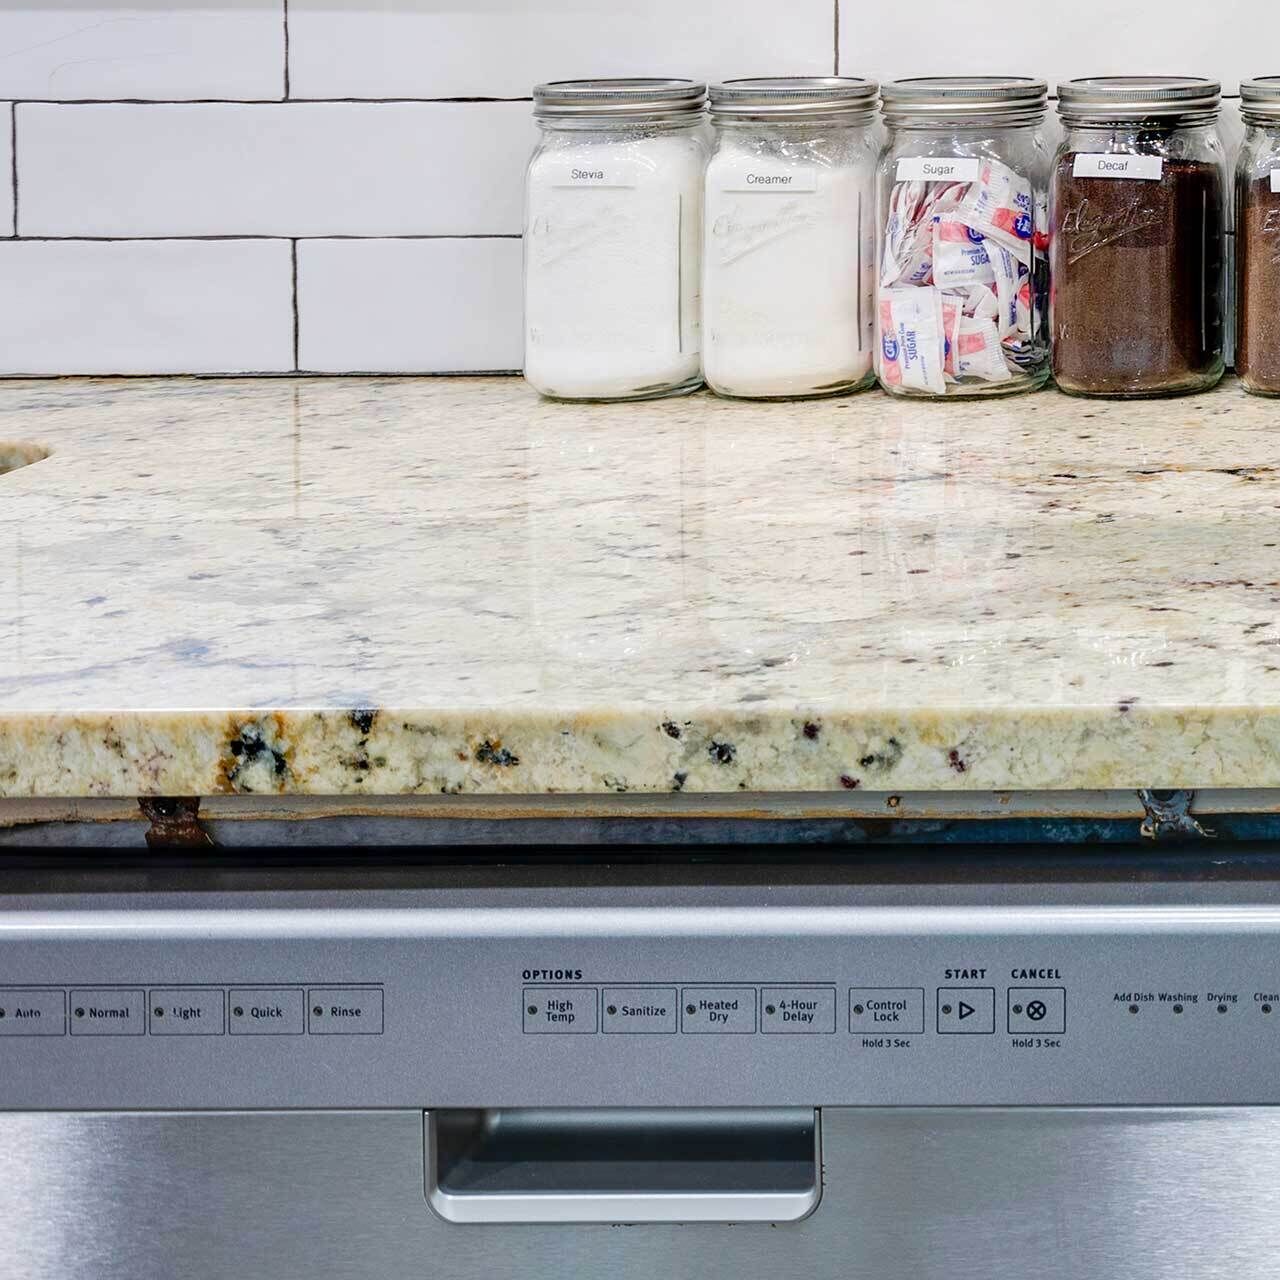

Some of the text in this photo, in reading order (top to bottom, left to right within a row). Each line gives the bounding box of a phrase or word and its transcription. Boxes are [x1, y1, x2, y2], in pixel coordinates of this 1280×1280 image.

[923, 163, 955, 175] Sugar
[1097, 160, 1129, 172] Decaf
[571, 168, 604, 181] Stevia
[746, 173, 792, 185] Creamer
[970, 253, 990, 266] SUGA
[906, 331, 917, 360] SUGAR
[522, 969, 583, 980] OPTIONS
[944, 969, 987, 979] START
[1011, 969, 1062, 979] CANCEL
[1113, 992, 1154, 1002] Add Dish
[1158, 992, 1198, 1003] Washing
[1207, 992, 1238, 1003] Drying
[1253, 992, 1280, 1002] Clean
[548, 1000, 573, 1011] High
[699, 1000, 738, 1010] Heated
[779, 1000, 818, 1010] 4-Hour
[866, 1000, 907, 1010] Control
[15, 1008, 41, 1018] Auto
[89, 1008, 129, 1018] Normal
[251, 1006, 282, 1018] Quick
[330, 1006, 361, 1017] Rinse
[621, 1006, 666, 1016] Sanitize
[873, 1011, 899, 1022] Lock
[546, 1011, 575, 1024] Temp
[709, 1012, 728, 1024] Dry
[783, 1011, 814, 1024] Delay
[862, 1039, 911, 1048] Hold 3 Sec
[1012, 1038, 1061, 1048] Hold 3 Sec
